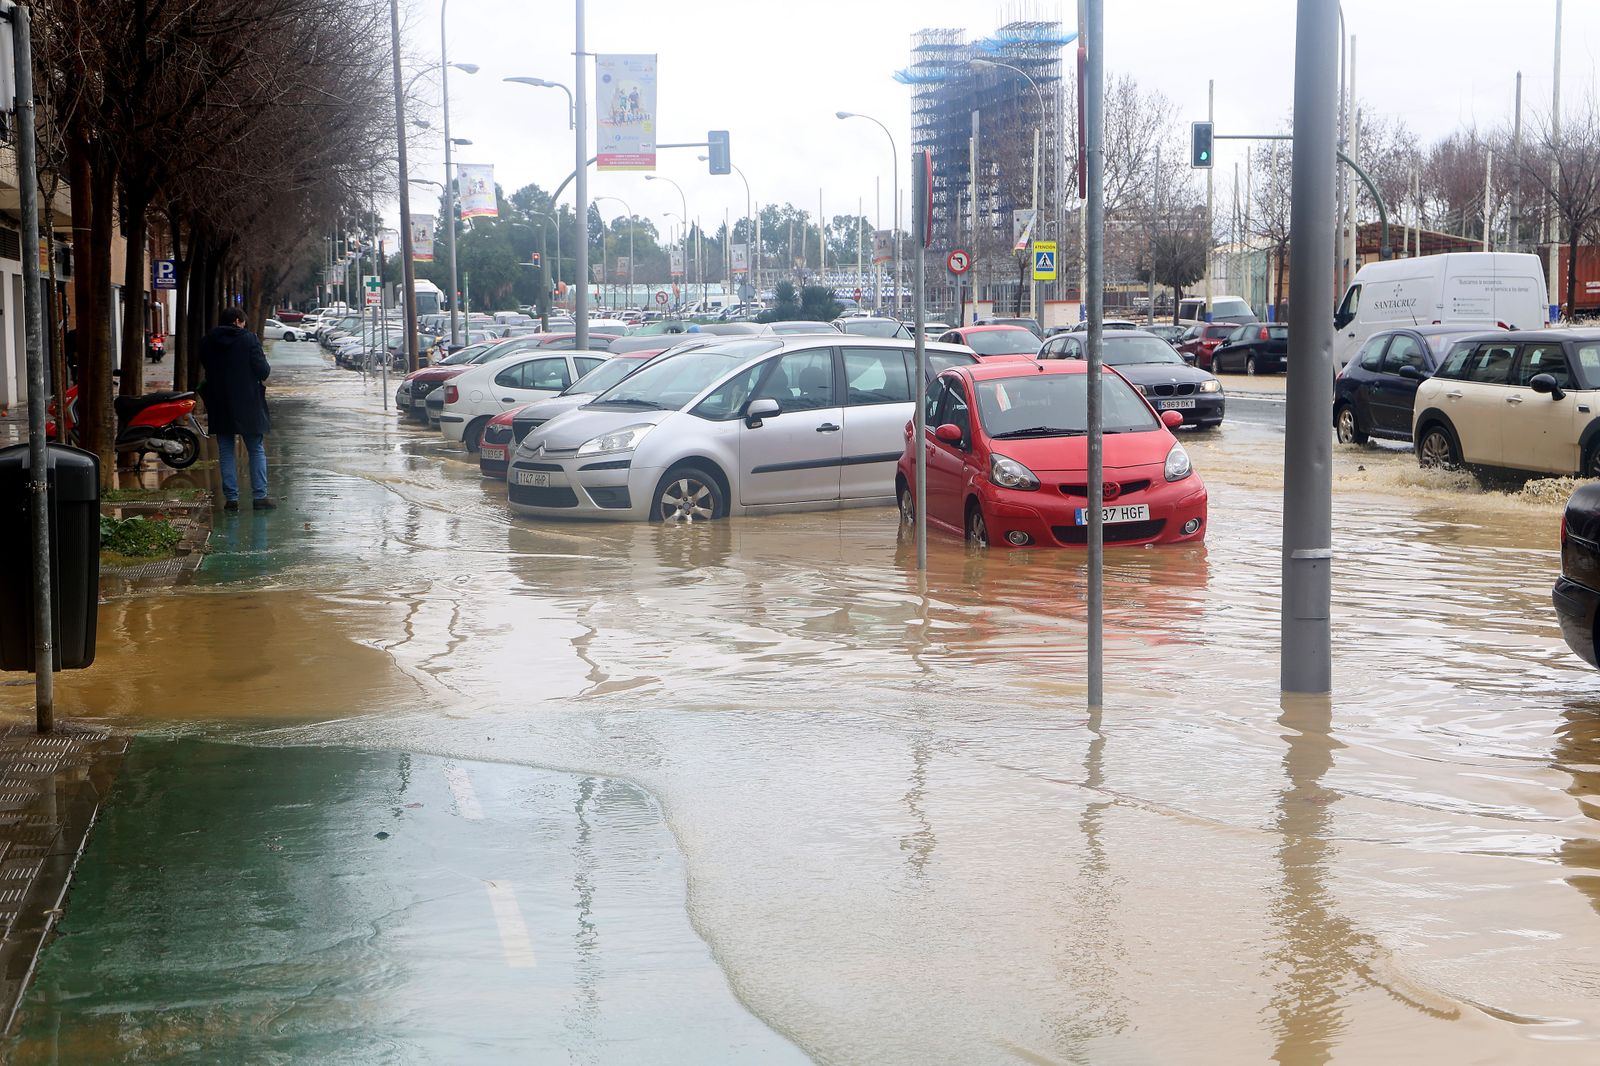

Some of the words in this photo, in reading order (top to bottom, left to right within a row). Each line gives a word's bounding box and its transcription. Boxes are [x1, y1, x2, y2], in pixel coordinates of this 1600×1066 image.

[158, 261, 174, 278] P
[1374, 298, 1416, 309] SANTACRUZ
[520, 472, 534, 484] 1147
[1085, 509, 1116, 521] 37
[1121, 506, 1144, 519] HGF
